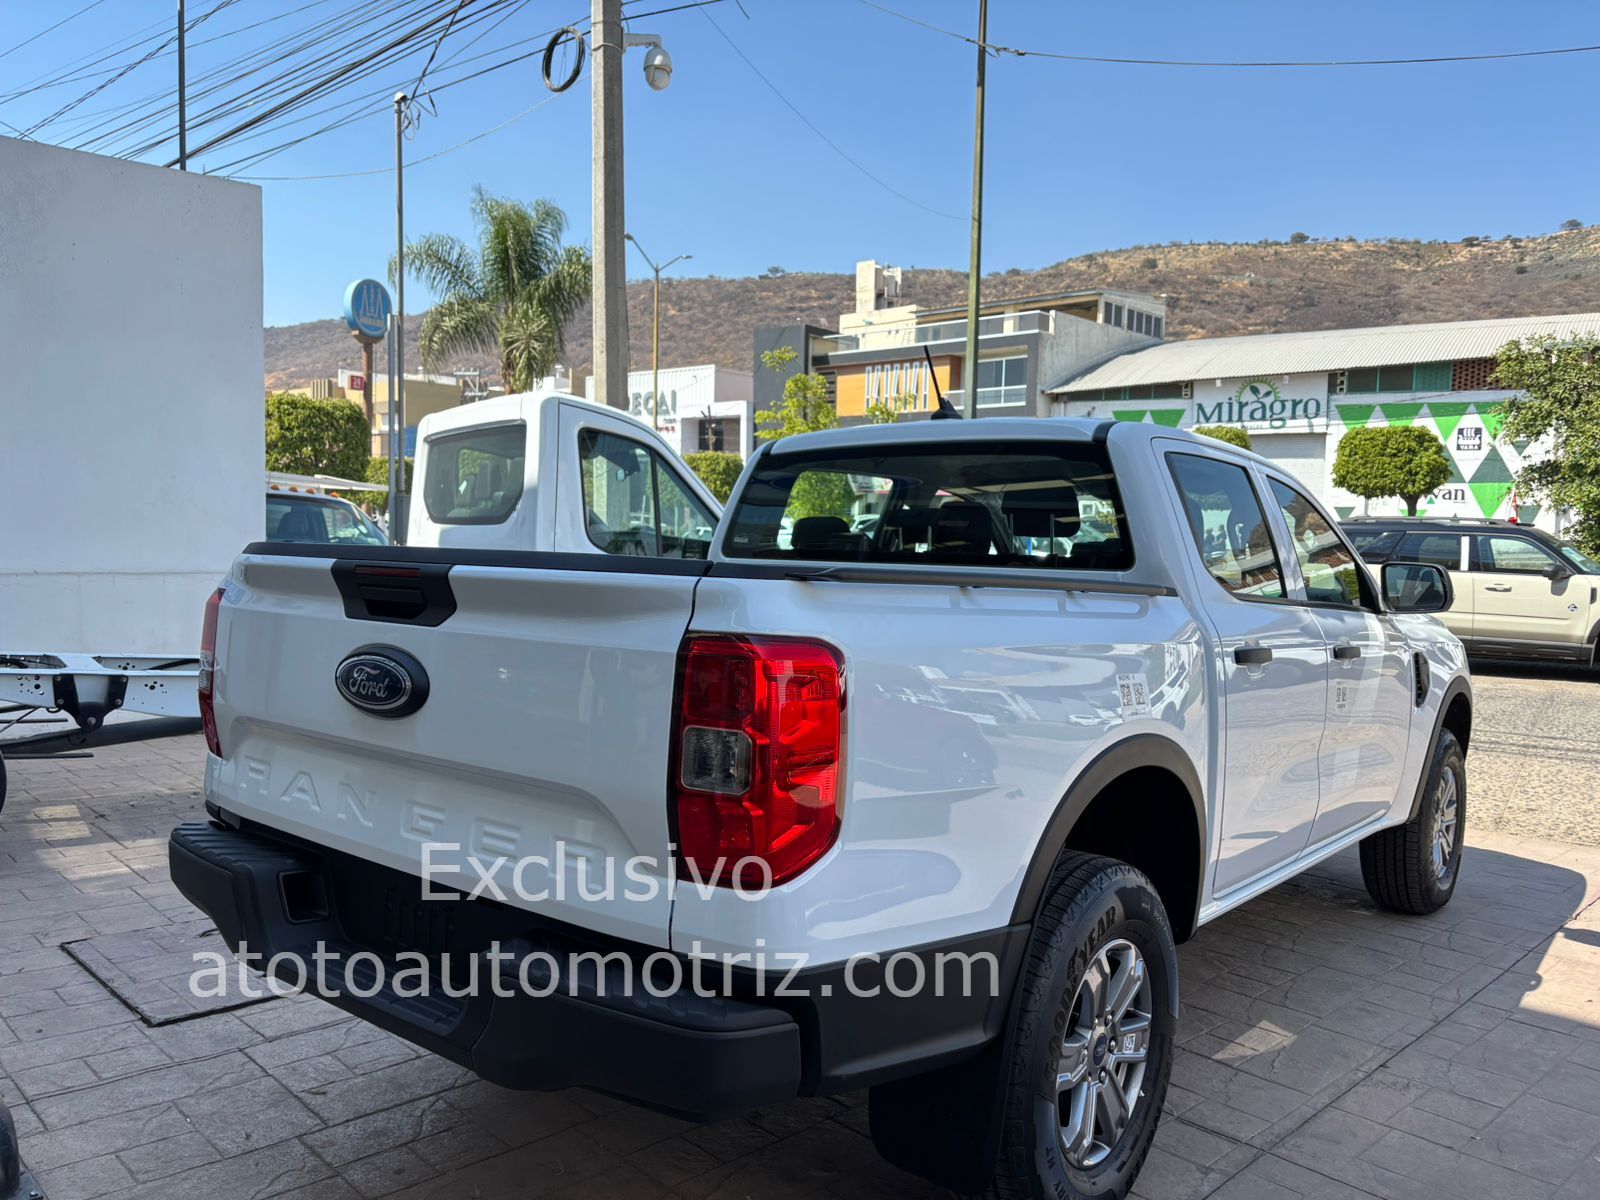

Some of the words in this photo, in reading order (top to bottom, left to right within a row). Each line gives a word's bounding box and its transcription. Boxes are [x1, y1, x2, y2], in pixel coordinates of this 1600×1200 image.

[1196, 396, 1321, 429] Miragro
[349, 665, 389, 698] Ford
[239, 754, 608, 894] RANGER
